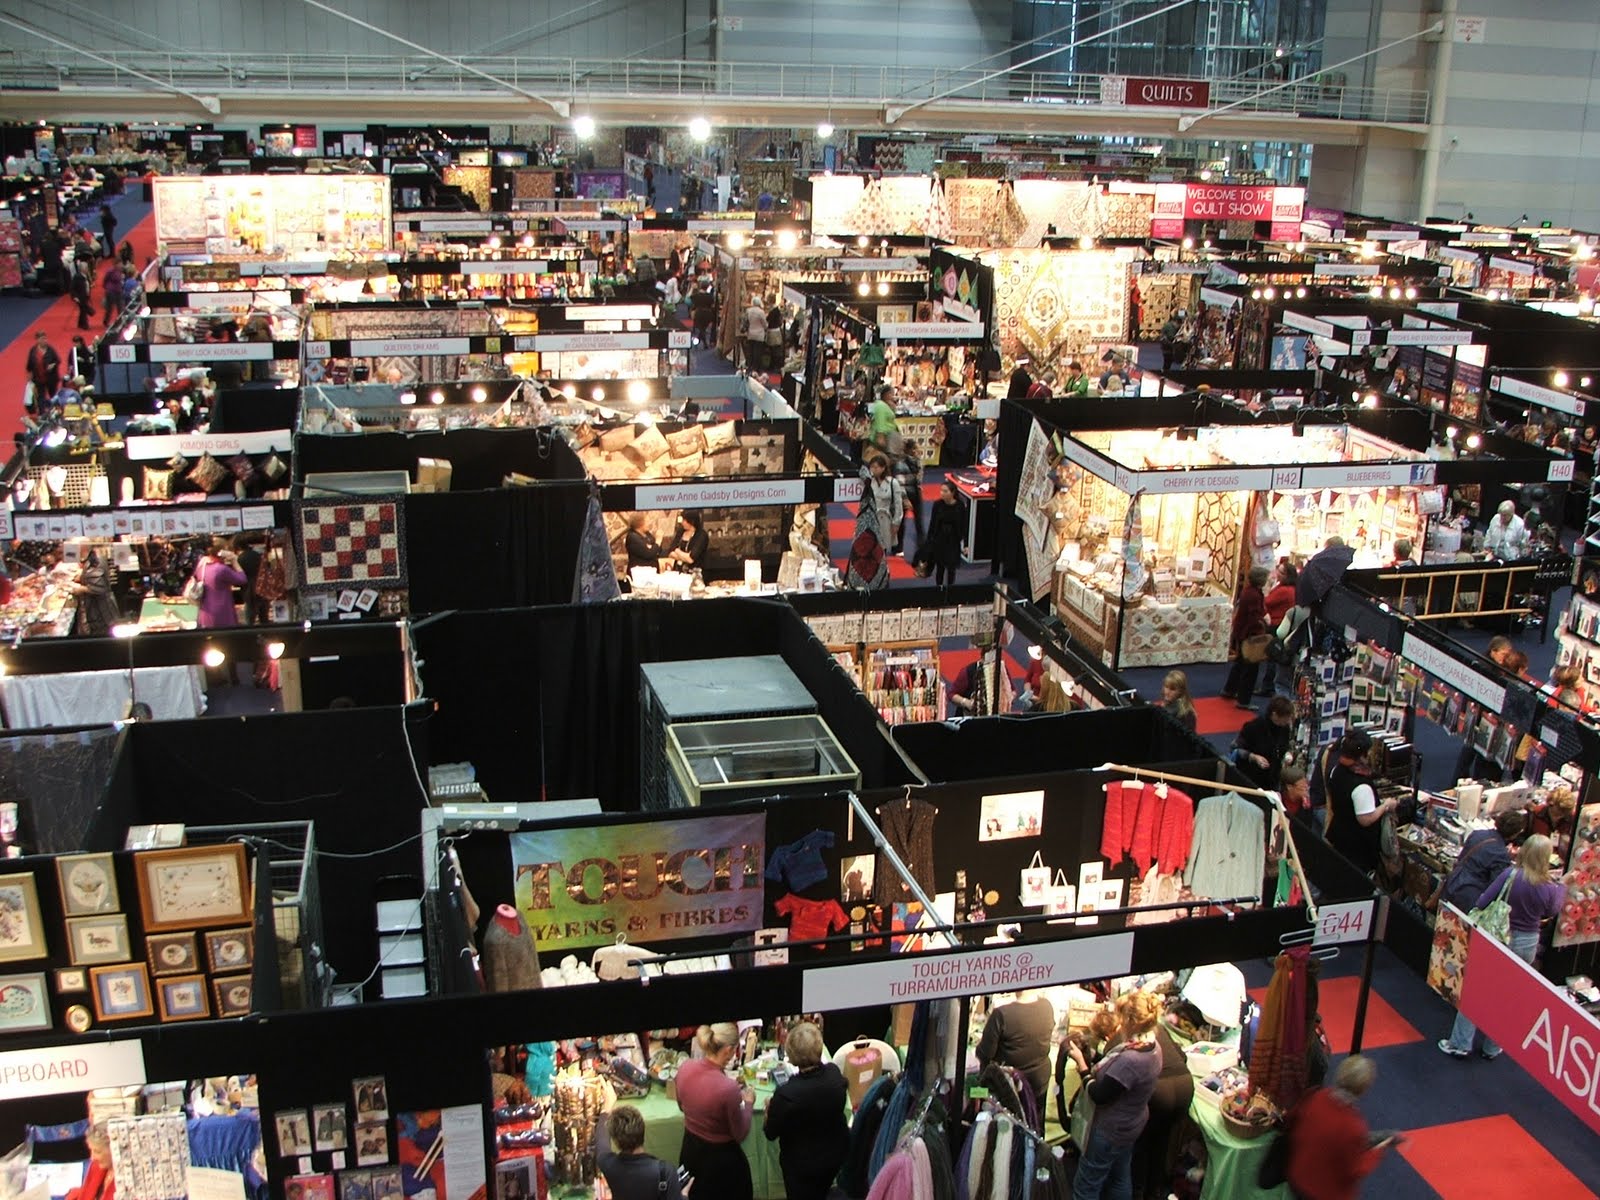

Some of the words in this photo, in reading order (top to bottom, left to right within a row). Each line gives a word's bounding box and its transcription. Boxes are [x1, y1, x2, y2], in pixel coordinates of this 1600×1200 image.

[1141, 84, 1194, 102] QUILTS
[1187, 188, 1237, 201] WELCOME
[1240, 190, 1254, 201] TO
[1256, 190, 1273, 202] THE
[1192, 202, 1224, 215] QUILT
[1228, 203, 1266, 216] SHOW
[213, 347, 248, 356] AUSTRALIA
[180, 440, 213, 450] KIMONO
[216, 439, 241, 449] GIRLS
[1346, 471, 1392, 482] BLUEBERRIES
[1551, 464, 1571, 477] H40
[1117, 473, 1129, 489] H42
[1163, 477, 1193, 488] CHERRY
[1194, 477, 1206, 487] PIE
[1207, 475, 1240, 487] DESIGNS
[1275, 472, 1298, 486] H42
[700, 490, 731, 502] Gadsby
[838, 482, 862, 497] H46
[516, 844, 763, 912] TOUCH
[530, 918, 614, 942] YARNS
[627, 914, 648, 933] &
[659, 905, 750, 928] FIBRES
[1322, 910, 1363, 935] G44
[912, 958, 961, 978] TOUCH
[965, 954, 1011, 973] YARNS
[1015, 952, 1034, 968] @
[889, 972, 987, 997] TURRAMURRA
[991, 964, 1054, 986] DRAPERY
[0, 1058, 88, 1085] PBOARD
